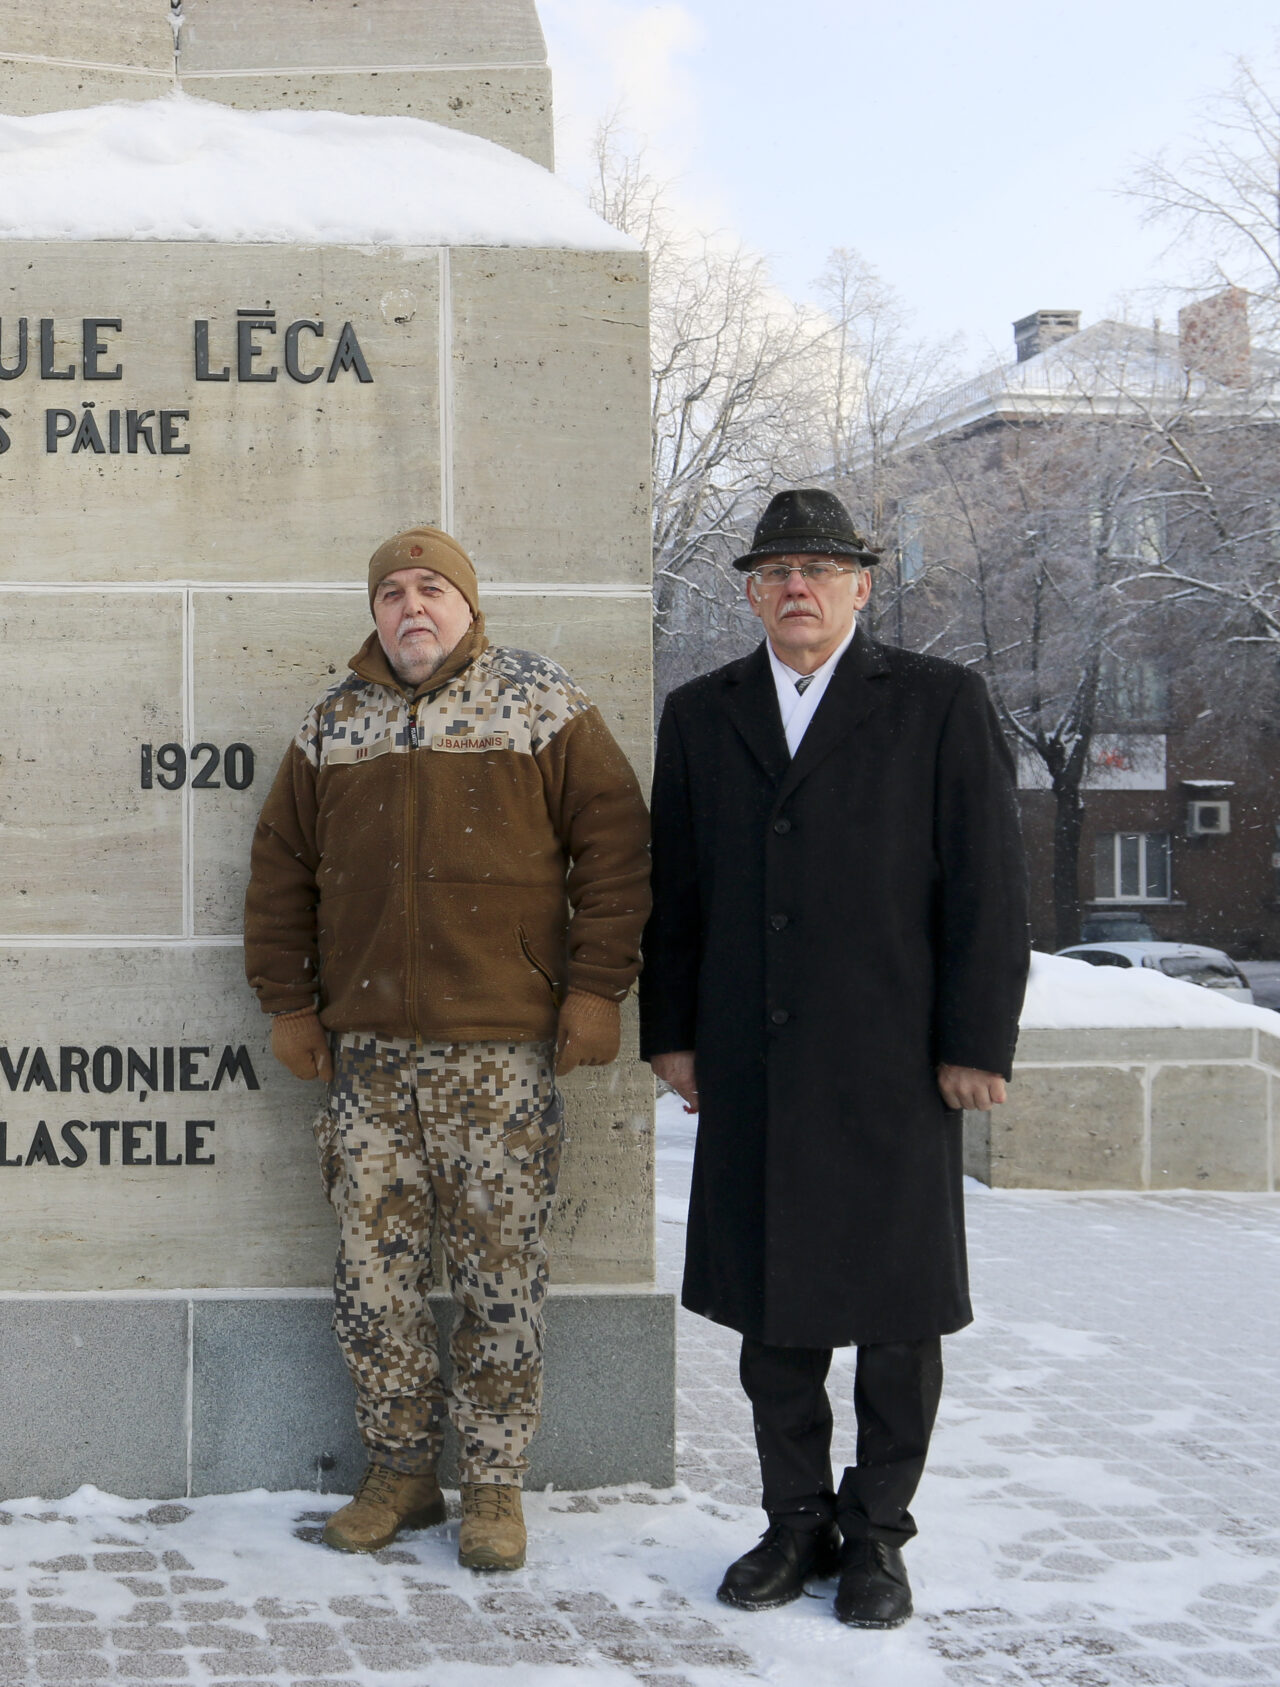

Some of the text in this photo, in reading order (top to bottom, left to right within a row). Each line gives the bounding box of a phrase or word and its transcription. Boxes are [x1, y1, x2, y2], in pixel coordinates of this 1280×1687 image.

[194, 308, 375, 384] LĒCA
[45, 401, 191, 455] PÄIKE
[141, 742, 255, 791] 1920
